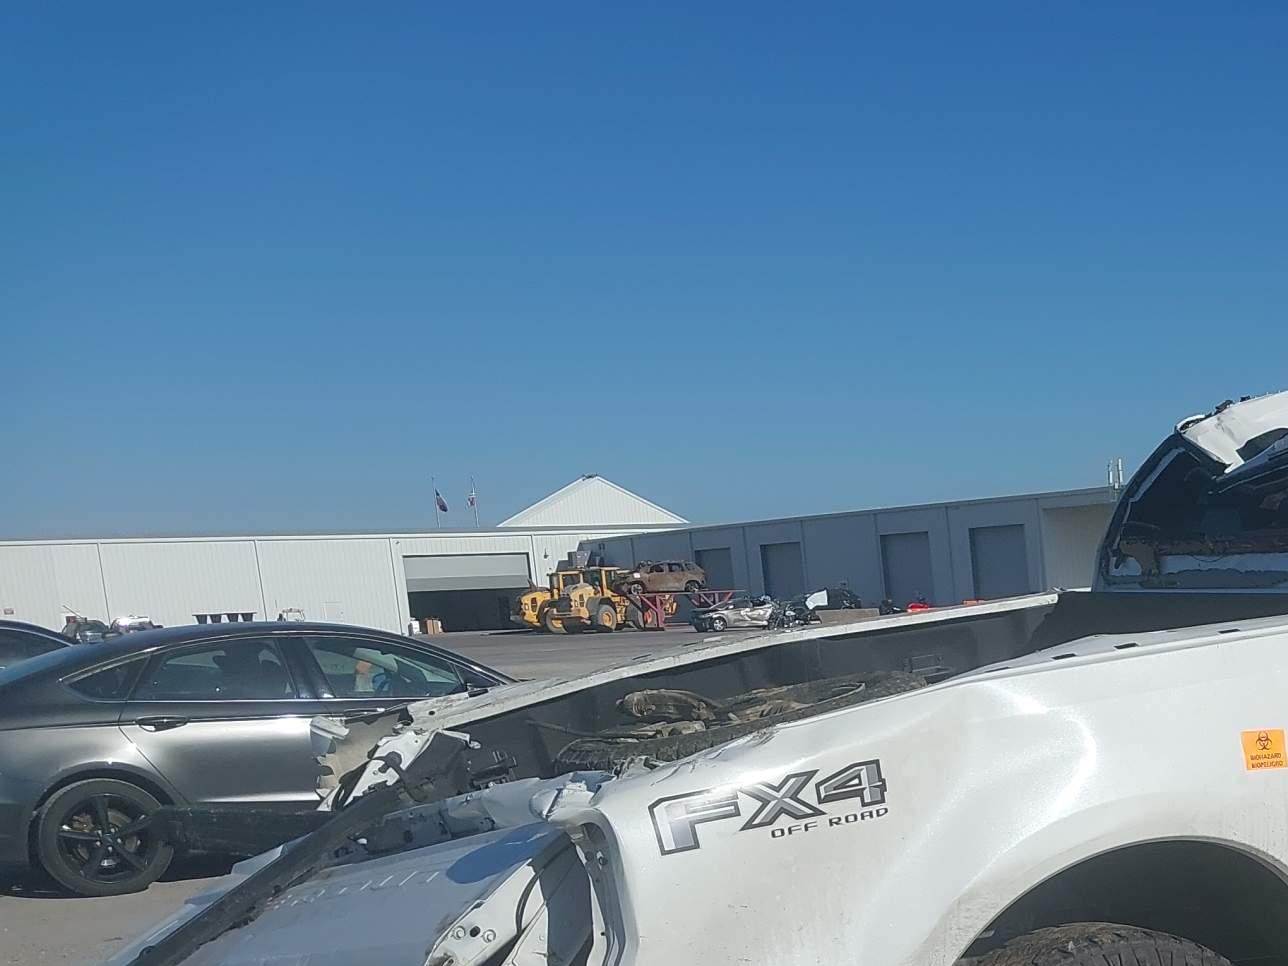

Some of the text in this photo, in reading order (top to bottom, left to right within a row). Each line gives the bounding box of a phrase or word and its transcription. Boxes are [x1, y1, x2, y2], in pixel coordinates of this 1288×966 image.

[647, 758, 888, 857] FX4
[770, 806, 889, 840] OFF ROAD
